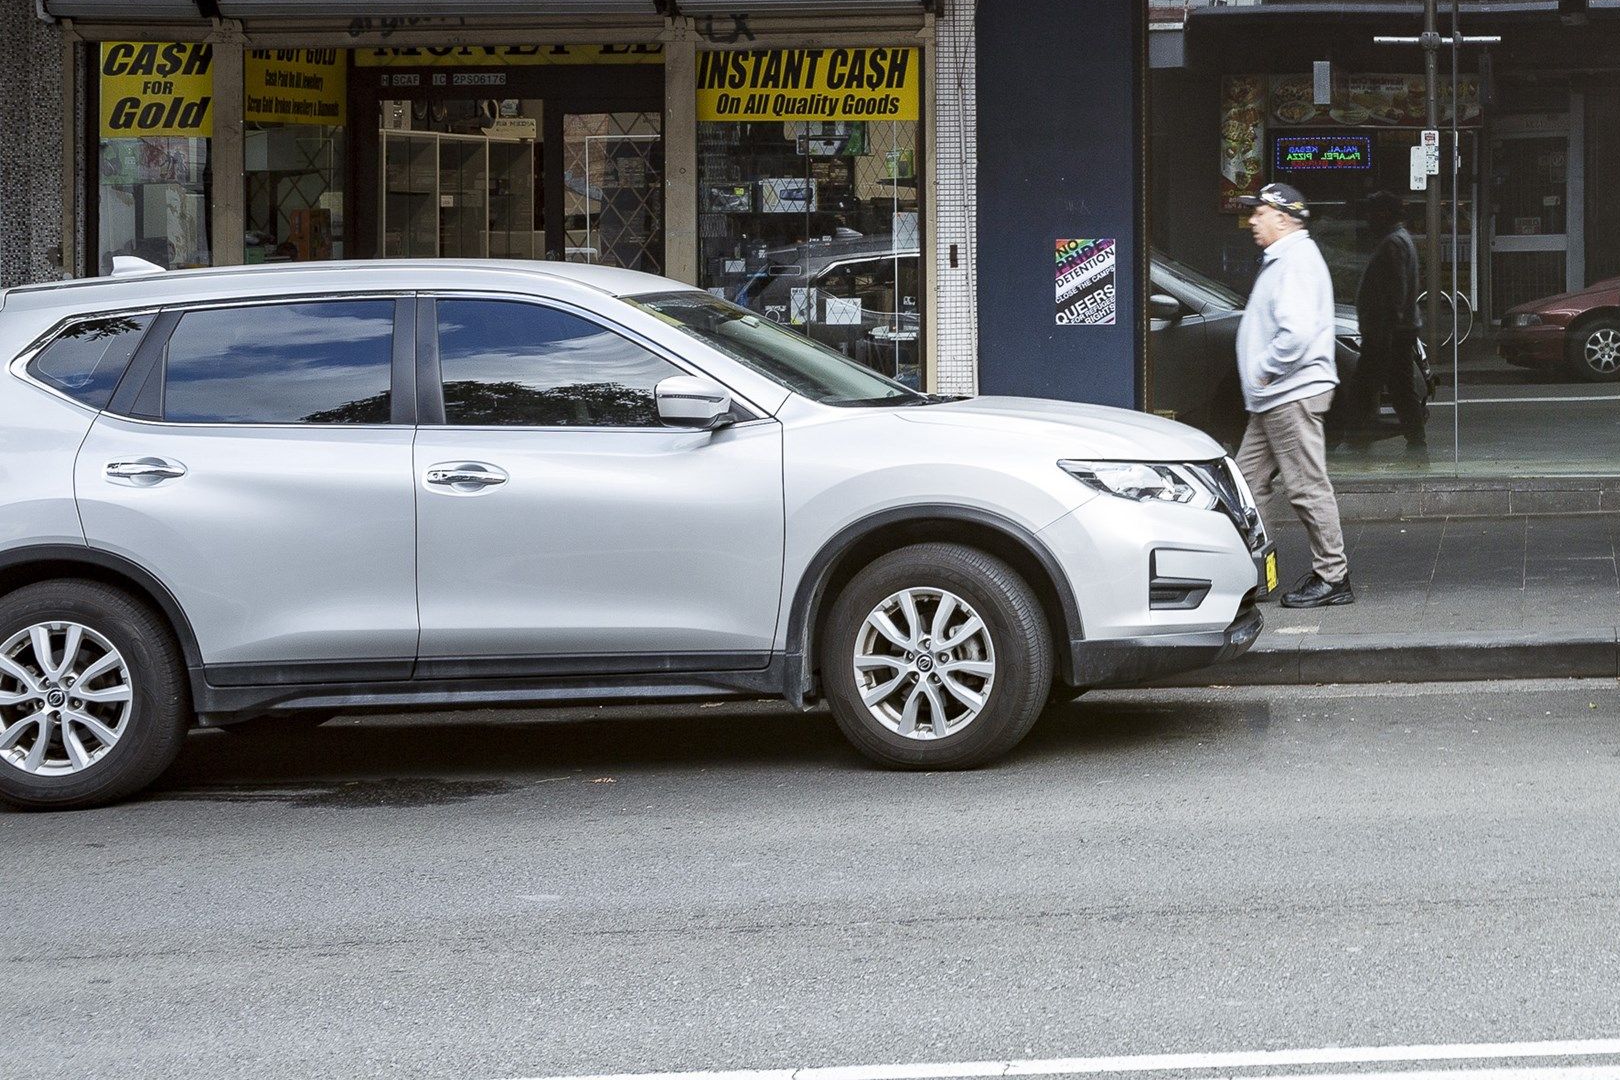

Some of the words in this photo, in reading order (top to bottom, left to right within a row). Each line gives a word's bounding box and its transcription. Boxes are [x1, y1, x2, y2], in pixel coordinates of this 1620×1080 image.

[698, 49, 823, 89] INSTANT
[143, 81, 173, 95] FOR
[716, 94, 741, 114] On
[743, 94, 770, 114] All
[772, 93, 840, 117] Quality
[842, 93, 900, 115] Goods
[109, 96, 211, 130] Gold
[1056, 240, 1078, 258] NO
[1055, 248, 1114, 287] DETENTION
[1055, 287, 1078, 304] CLOSE
[1079, 278, 1092, 291] THE
[1091, 264, 1115, 283] CAMPS
[1055, 284, 1115, 324] QUEERS
[1085, 304, 1115, 324] RIGHTS
